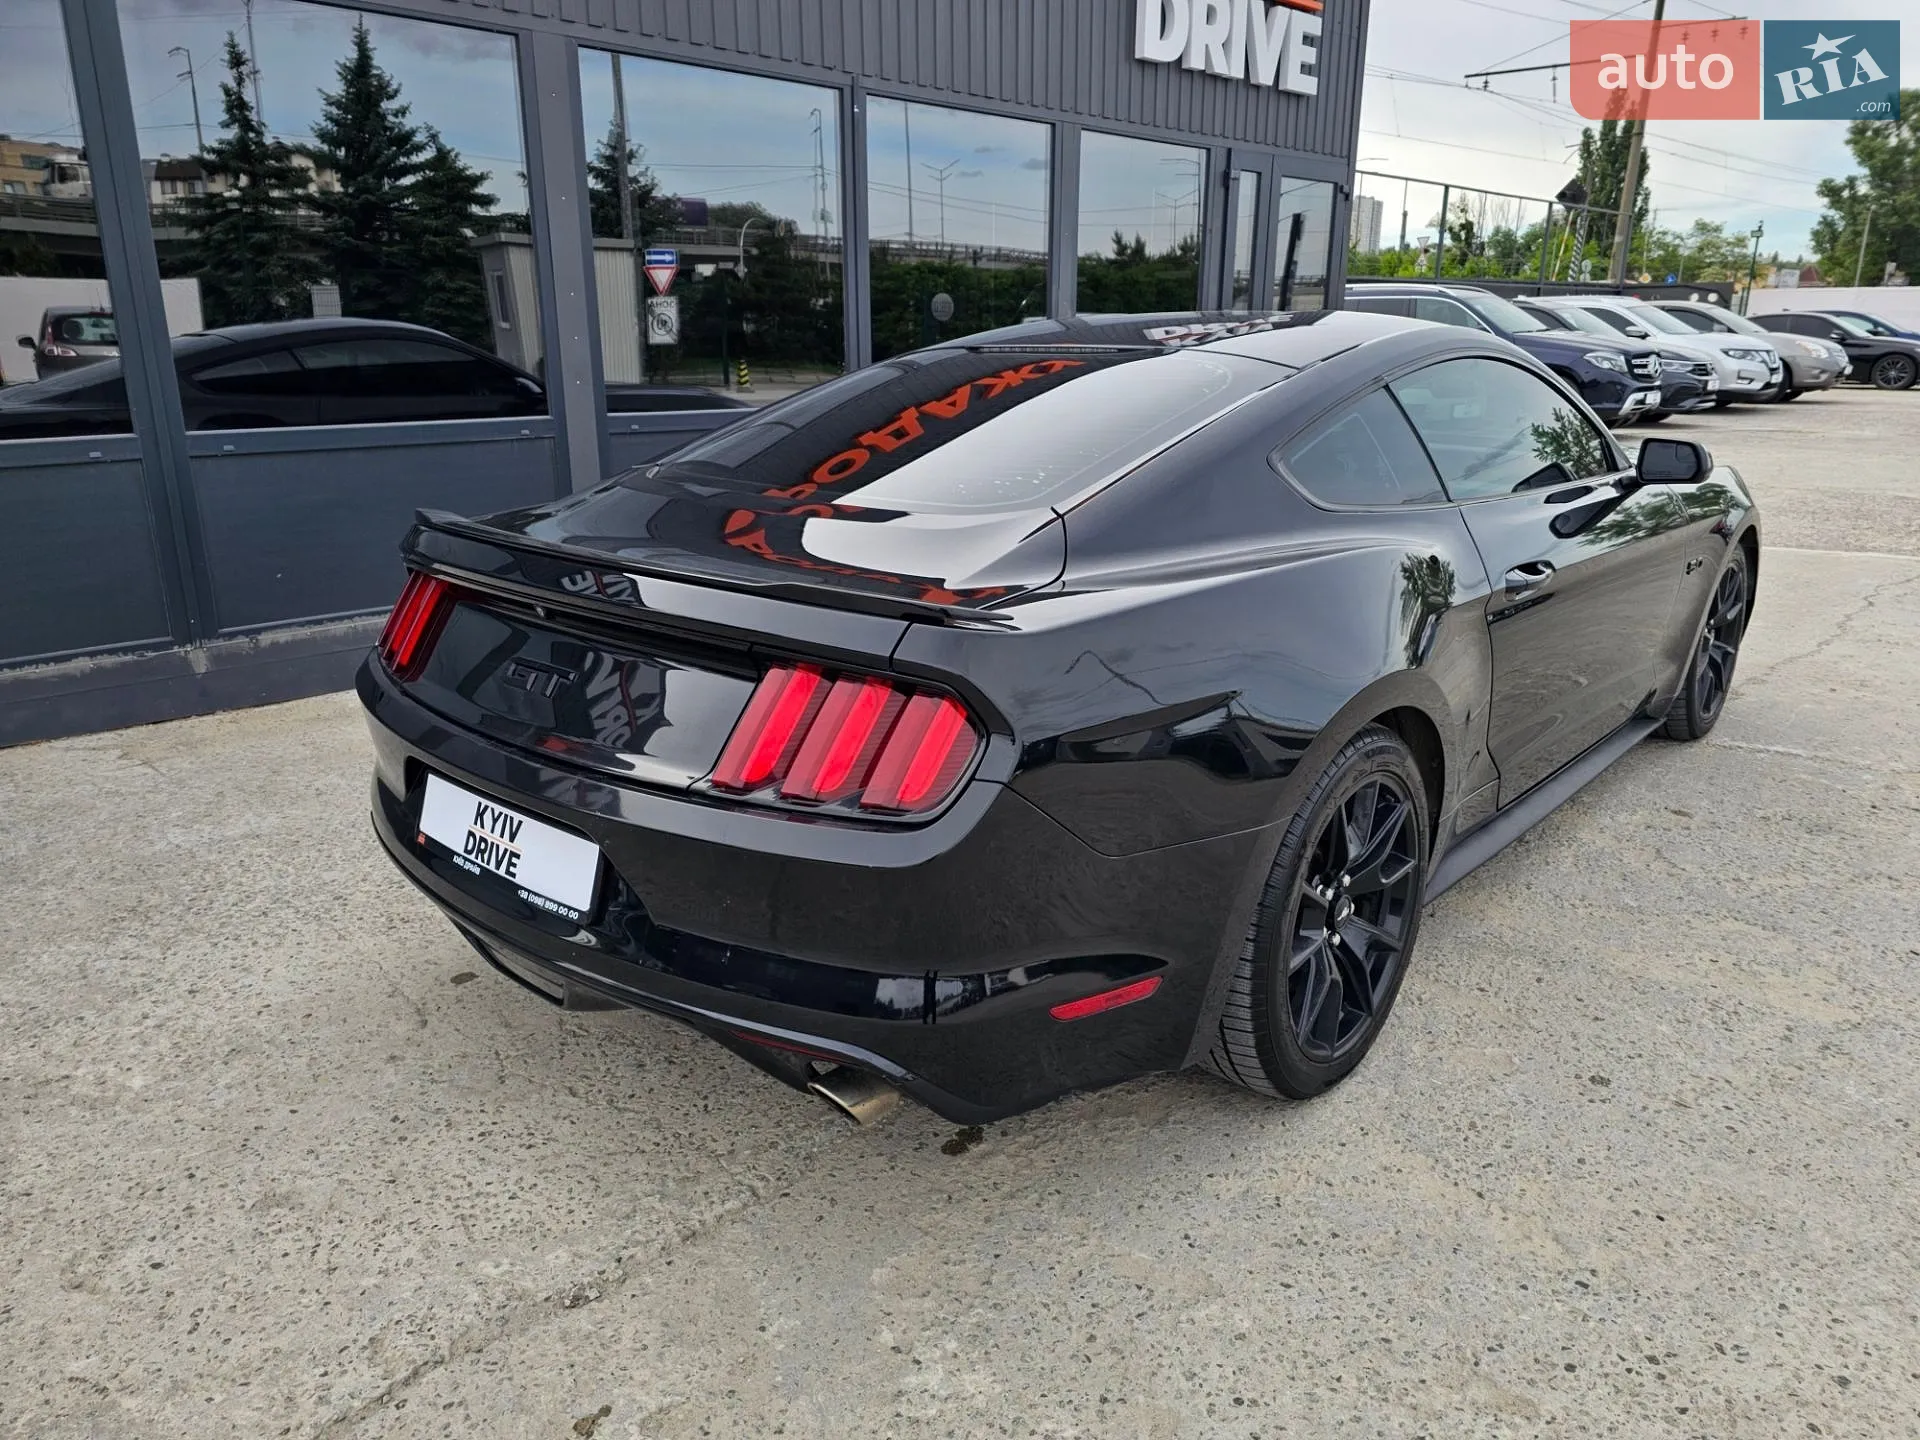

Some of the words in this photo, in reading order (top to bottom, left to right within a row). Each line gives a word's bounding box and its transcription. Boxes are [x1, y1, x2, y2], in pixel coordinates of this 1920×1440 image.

[1135, 0, 1322, 95] DRIVE
[473, 801, 523, 843] KYIV
[463, 829, 521, 879] DRIVE
[557, 906, 568, 916] 00
[568, 911, 579, 920] 00
